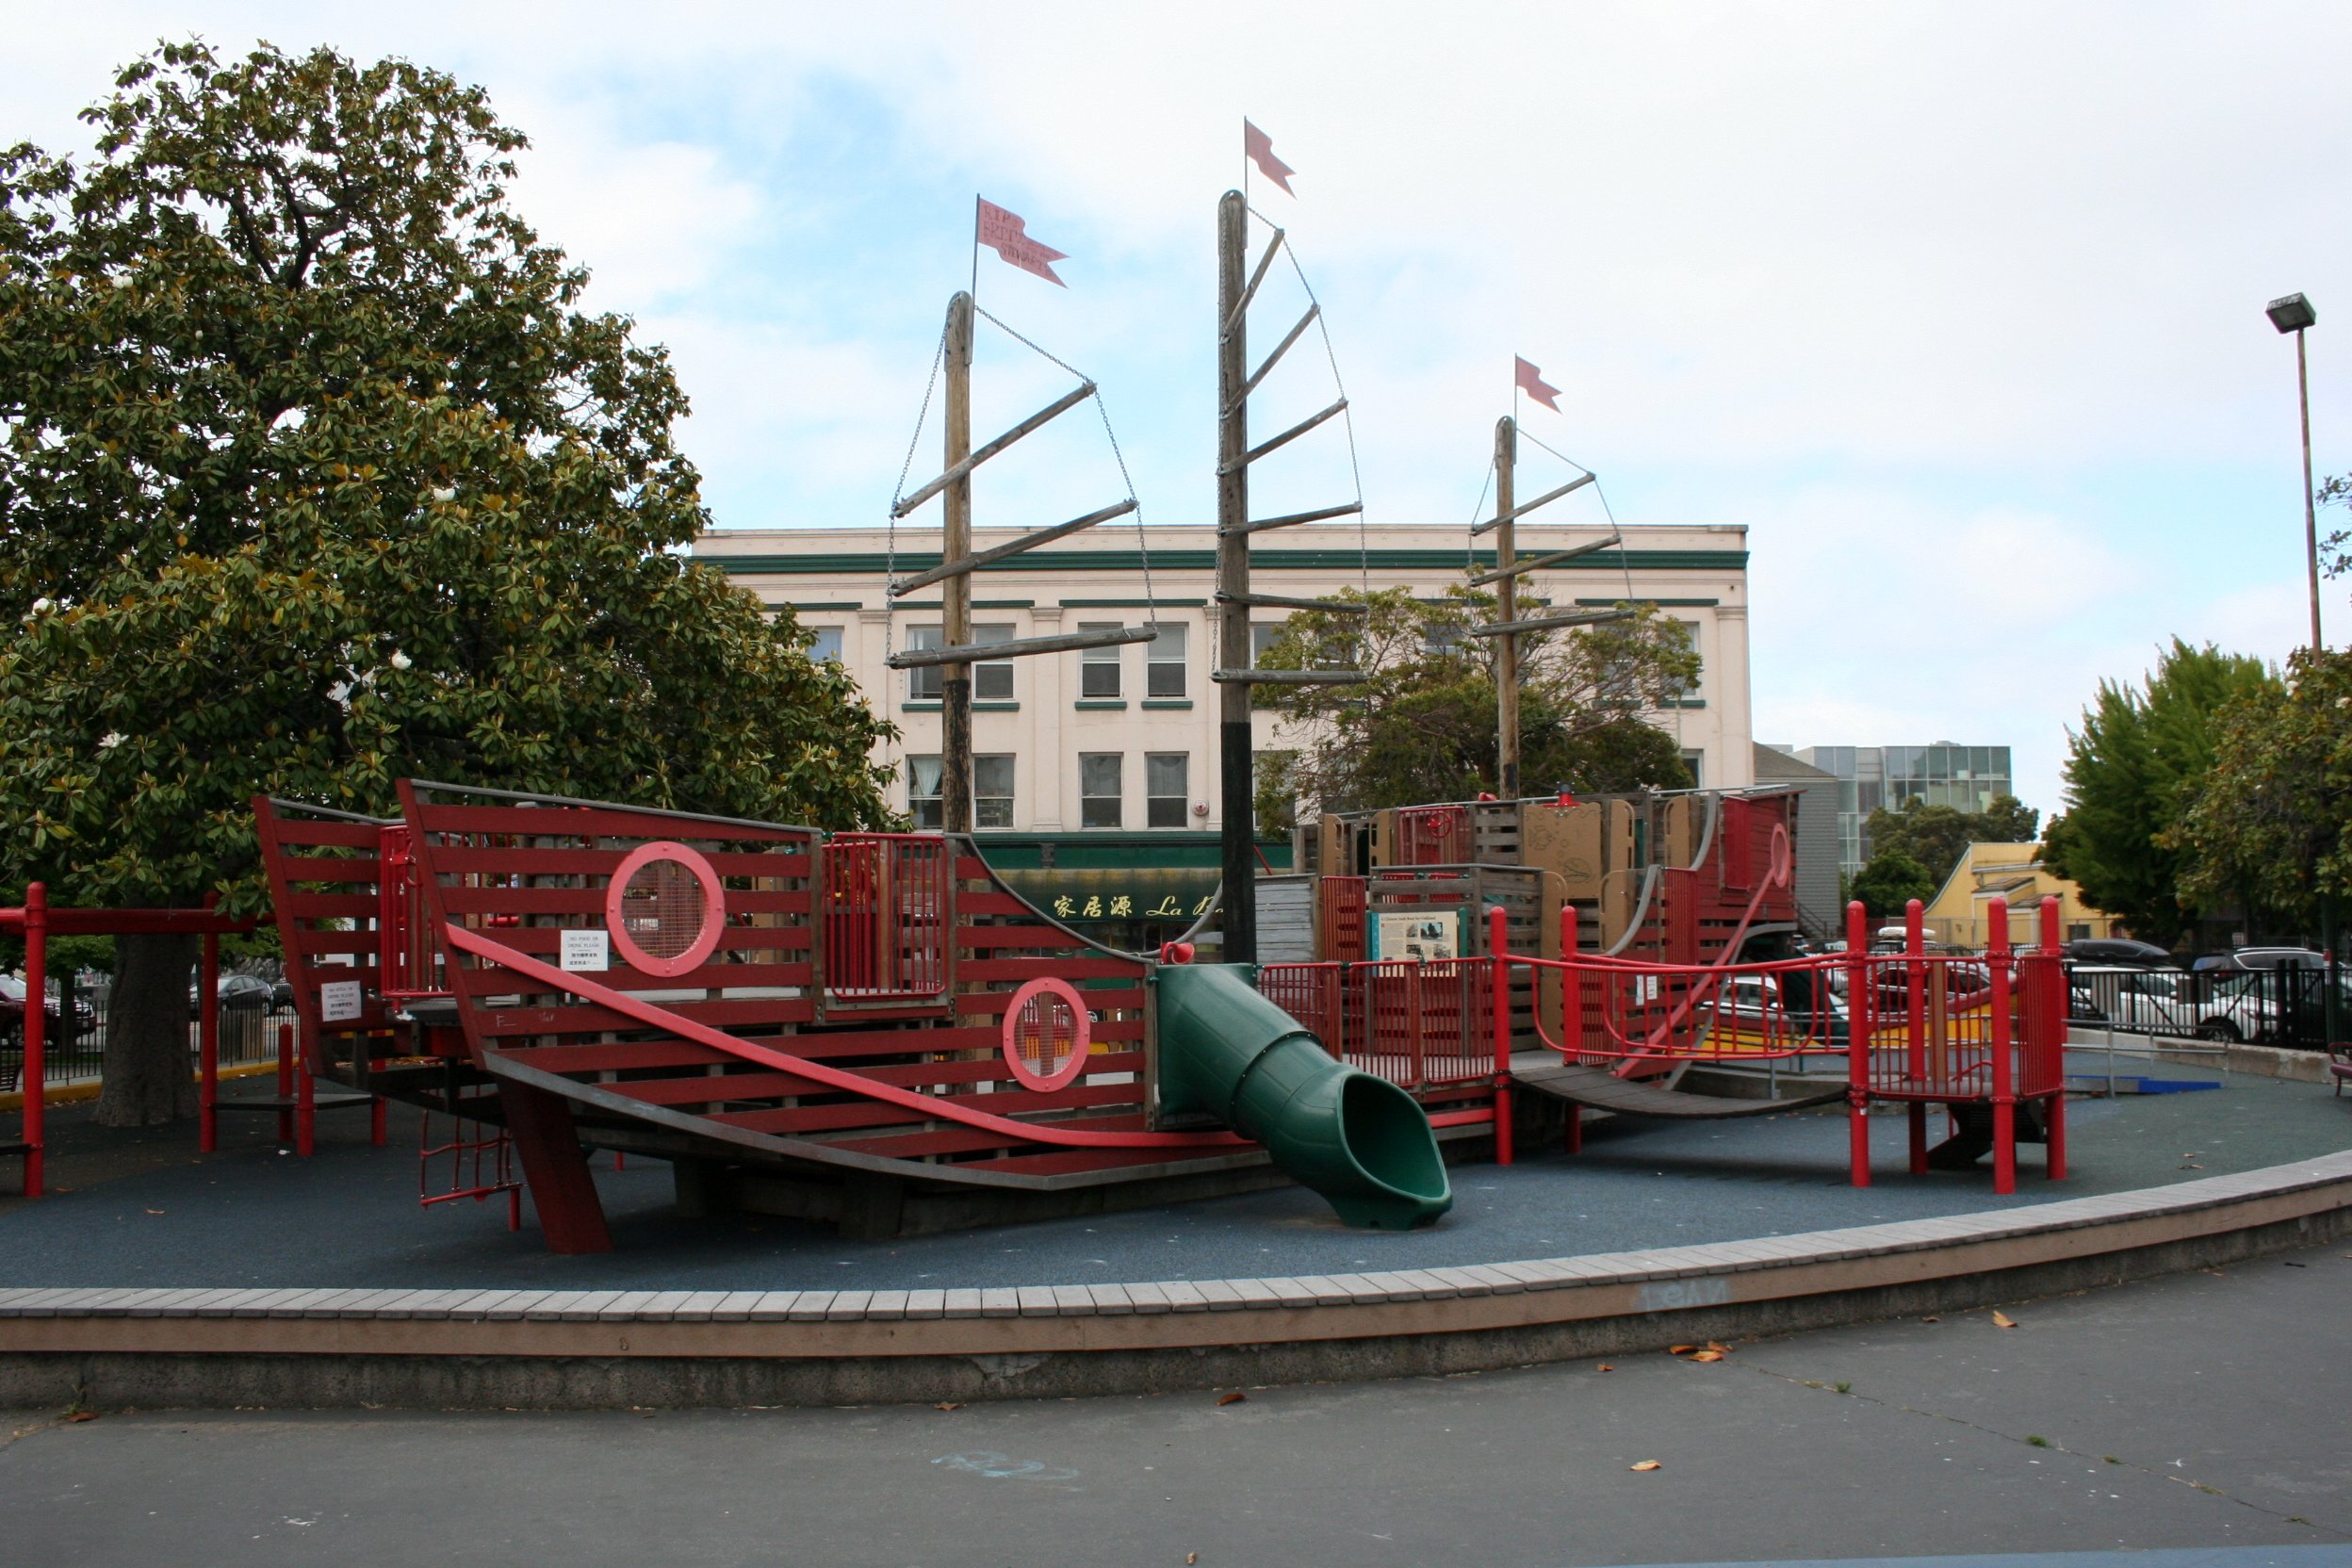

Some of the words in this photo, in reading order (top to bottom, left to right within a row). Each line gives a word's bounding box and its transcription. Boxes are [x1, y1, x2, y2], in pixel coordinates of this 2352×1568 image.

[1054, 895, 1133, 918] 家居源
[1146, 895, 1183, 916] La
